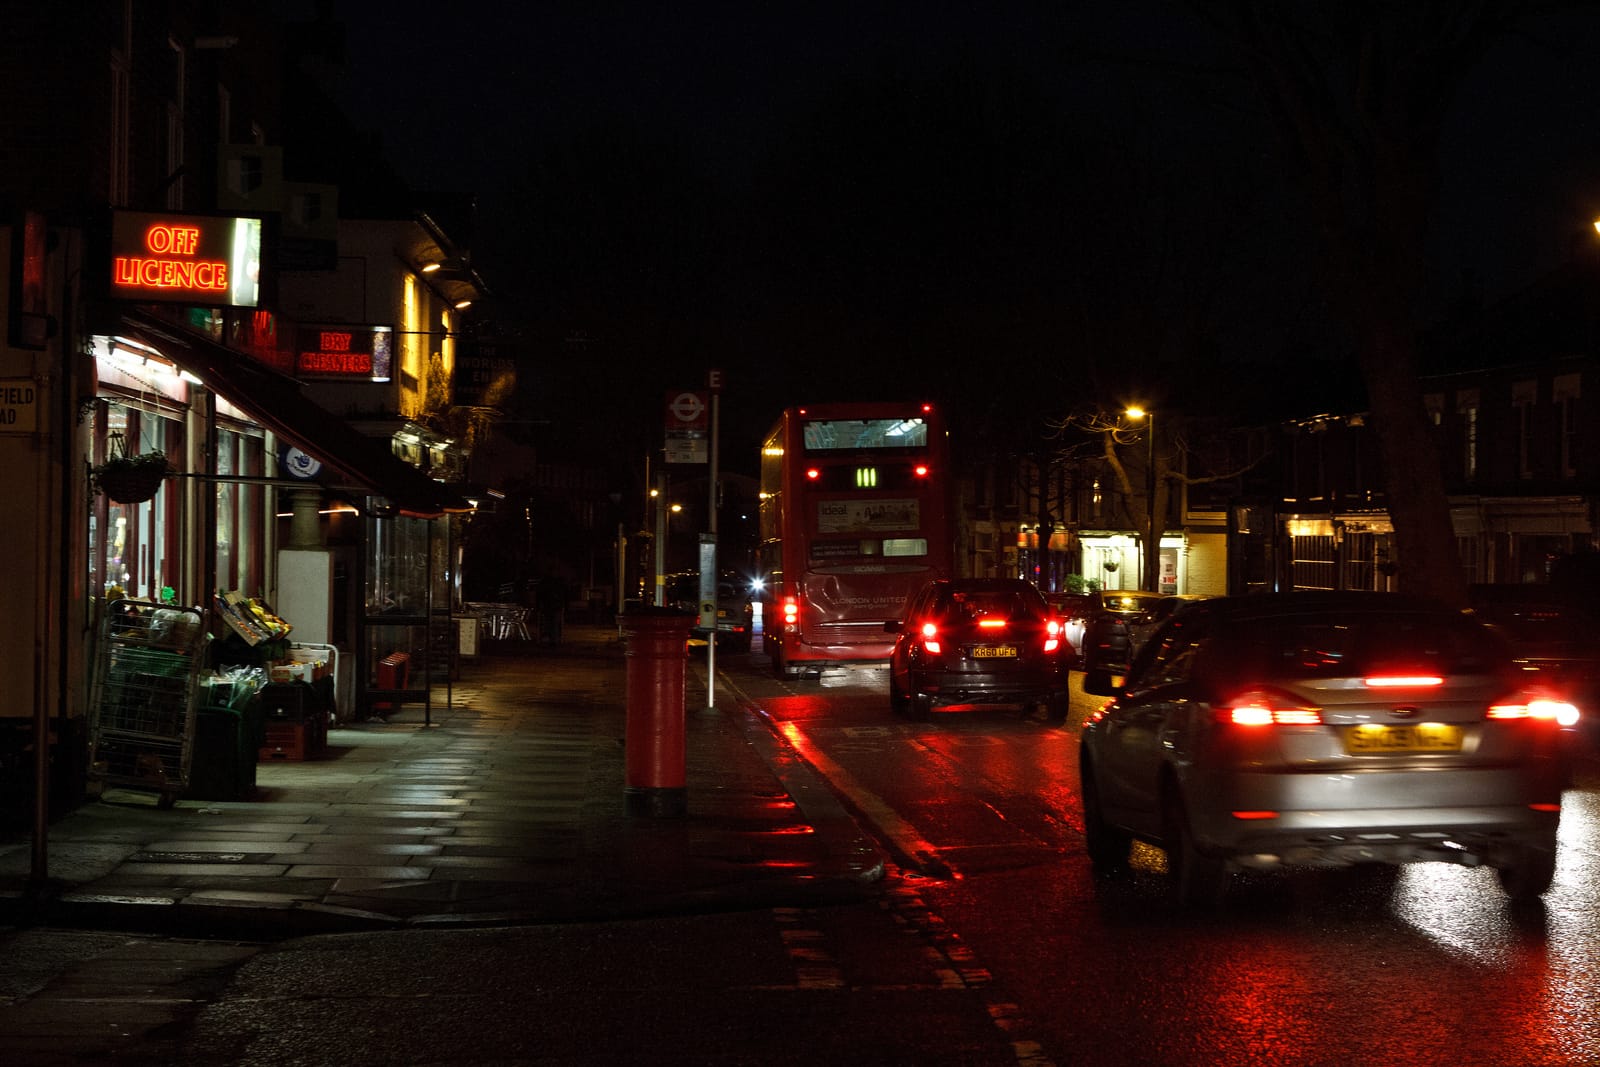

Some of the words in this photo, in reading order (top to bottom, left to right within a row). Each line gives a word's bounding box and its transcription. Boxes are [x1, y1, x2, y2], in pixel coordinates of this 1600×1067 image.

[147, 226, 199, 255] OFF
[114, 258, 228, 290] LICENCE
[320, 332, 352, 351] DRY
[302, 352, 371, 373] CLEANERS
[709, 370, 721, 388] E
[856, 467, 877, 488] 111
[873, 596, 907, 604] UNITED
[974, 648, 997, 657] KR60
